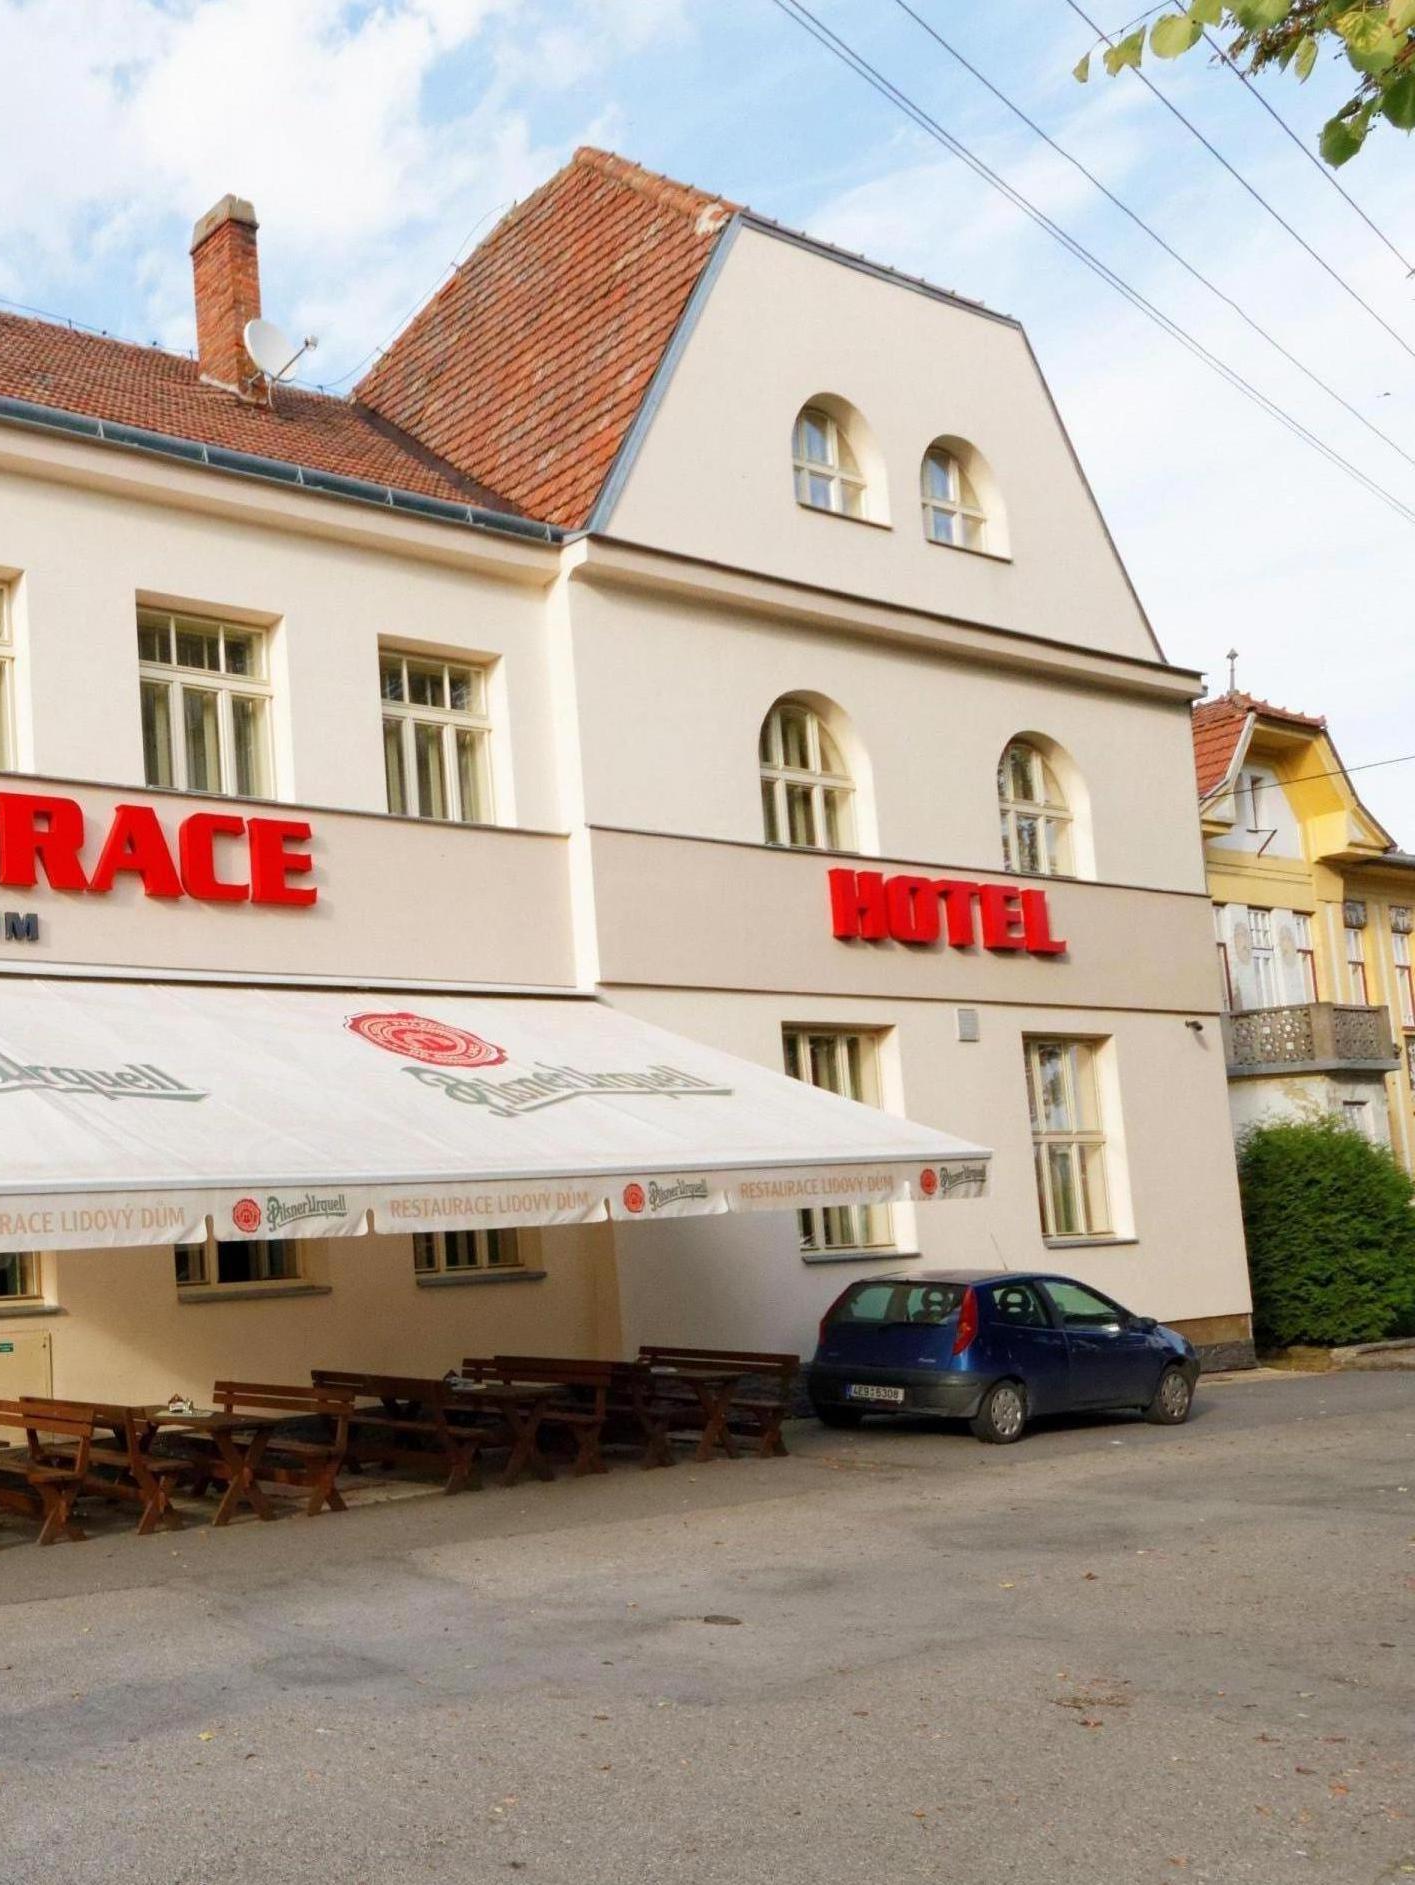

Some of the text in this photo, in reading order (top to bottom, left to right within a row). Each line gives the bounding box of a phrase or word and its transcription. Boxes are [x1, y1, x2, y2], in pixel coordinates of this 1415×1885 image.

[828, 868, 1067, 956] HOTEL
[400, 1065, 582, 1118] Pilsner
[390, 1196, 494, 1219] RESTAURACE
[739, 1178, 820, 1200] RESTAURACE
[61, 1202, 134, 1233] LIDOVÝ
[141, 1200, 185, 1229] DŮM
[267, 1192, 347, 1233] Pilsner Urquell
